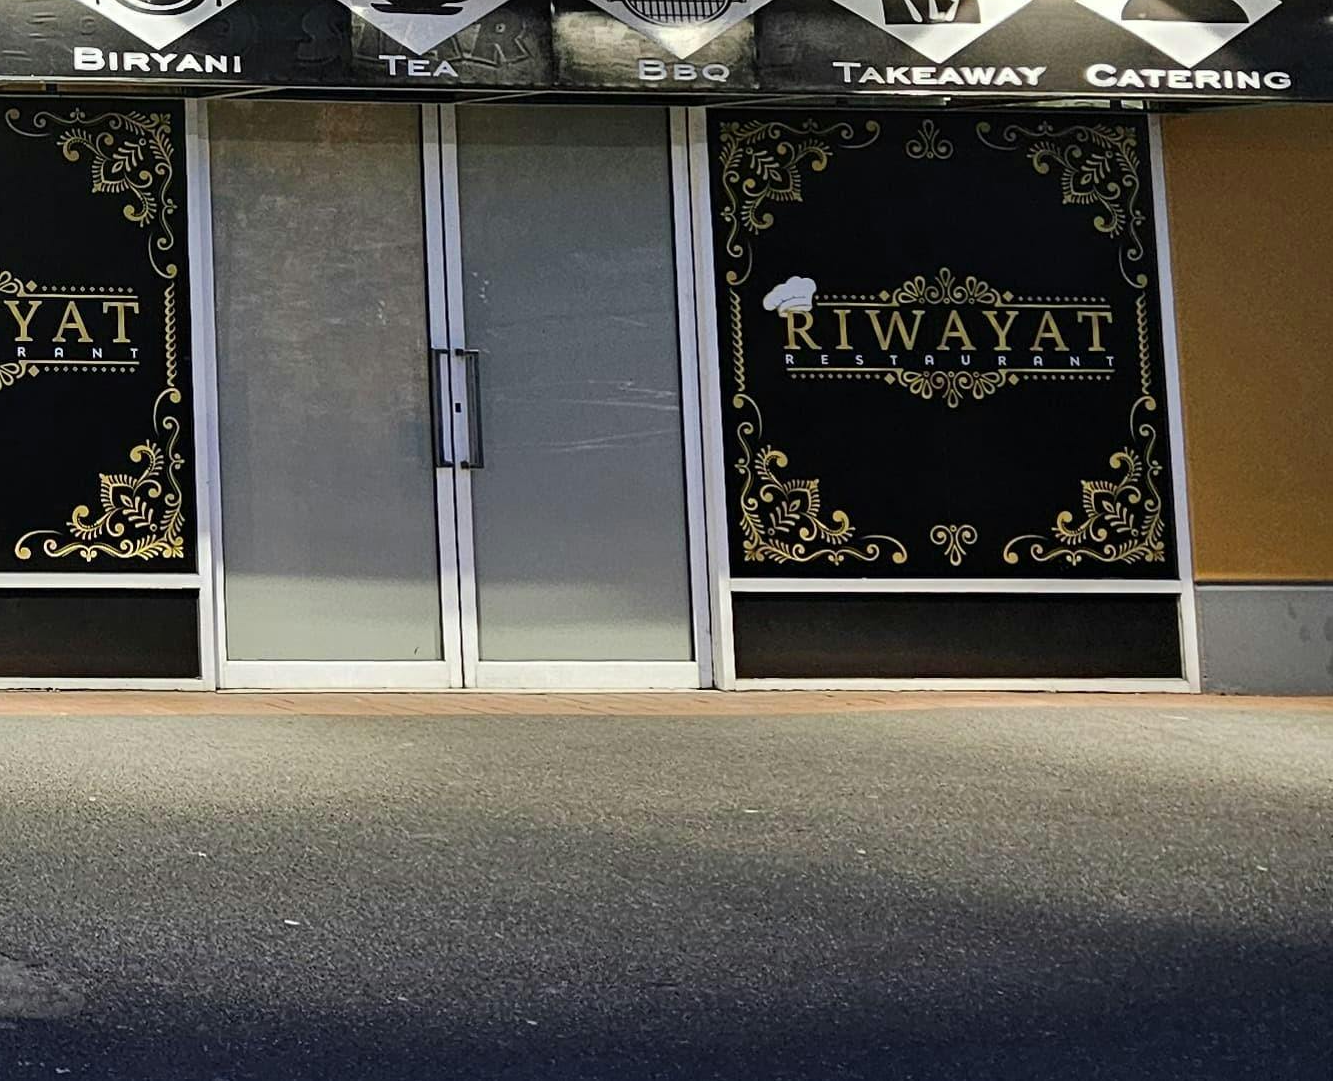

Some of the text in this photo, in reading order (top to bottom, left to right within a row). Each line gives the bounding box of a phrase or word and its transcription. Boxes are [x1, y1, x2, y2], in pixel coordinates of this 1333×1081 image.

[73, 46, 242, 74] BIRYANI
[379, 54, 459, 78] TEA
[637, 58, 732, 83] BBQ
[833, 61, 1047, 87] TAKEAWAY
[1086, 63, 1293, 90] CATERING
[783, 310, 1113, 352] RIWAYAT
[785, 353, 1115, 367] RESTAURANT
